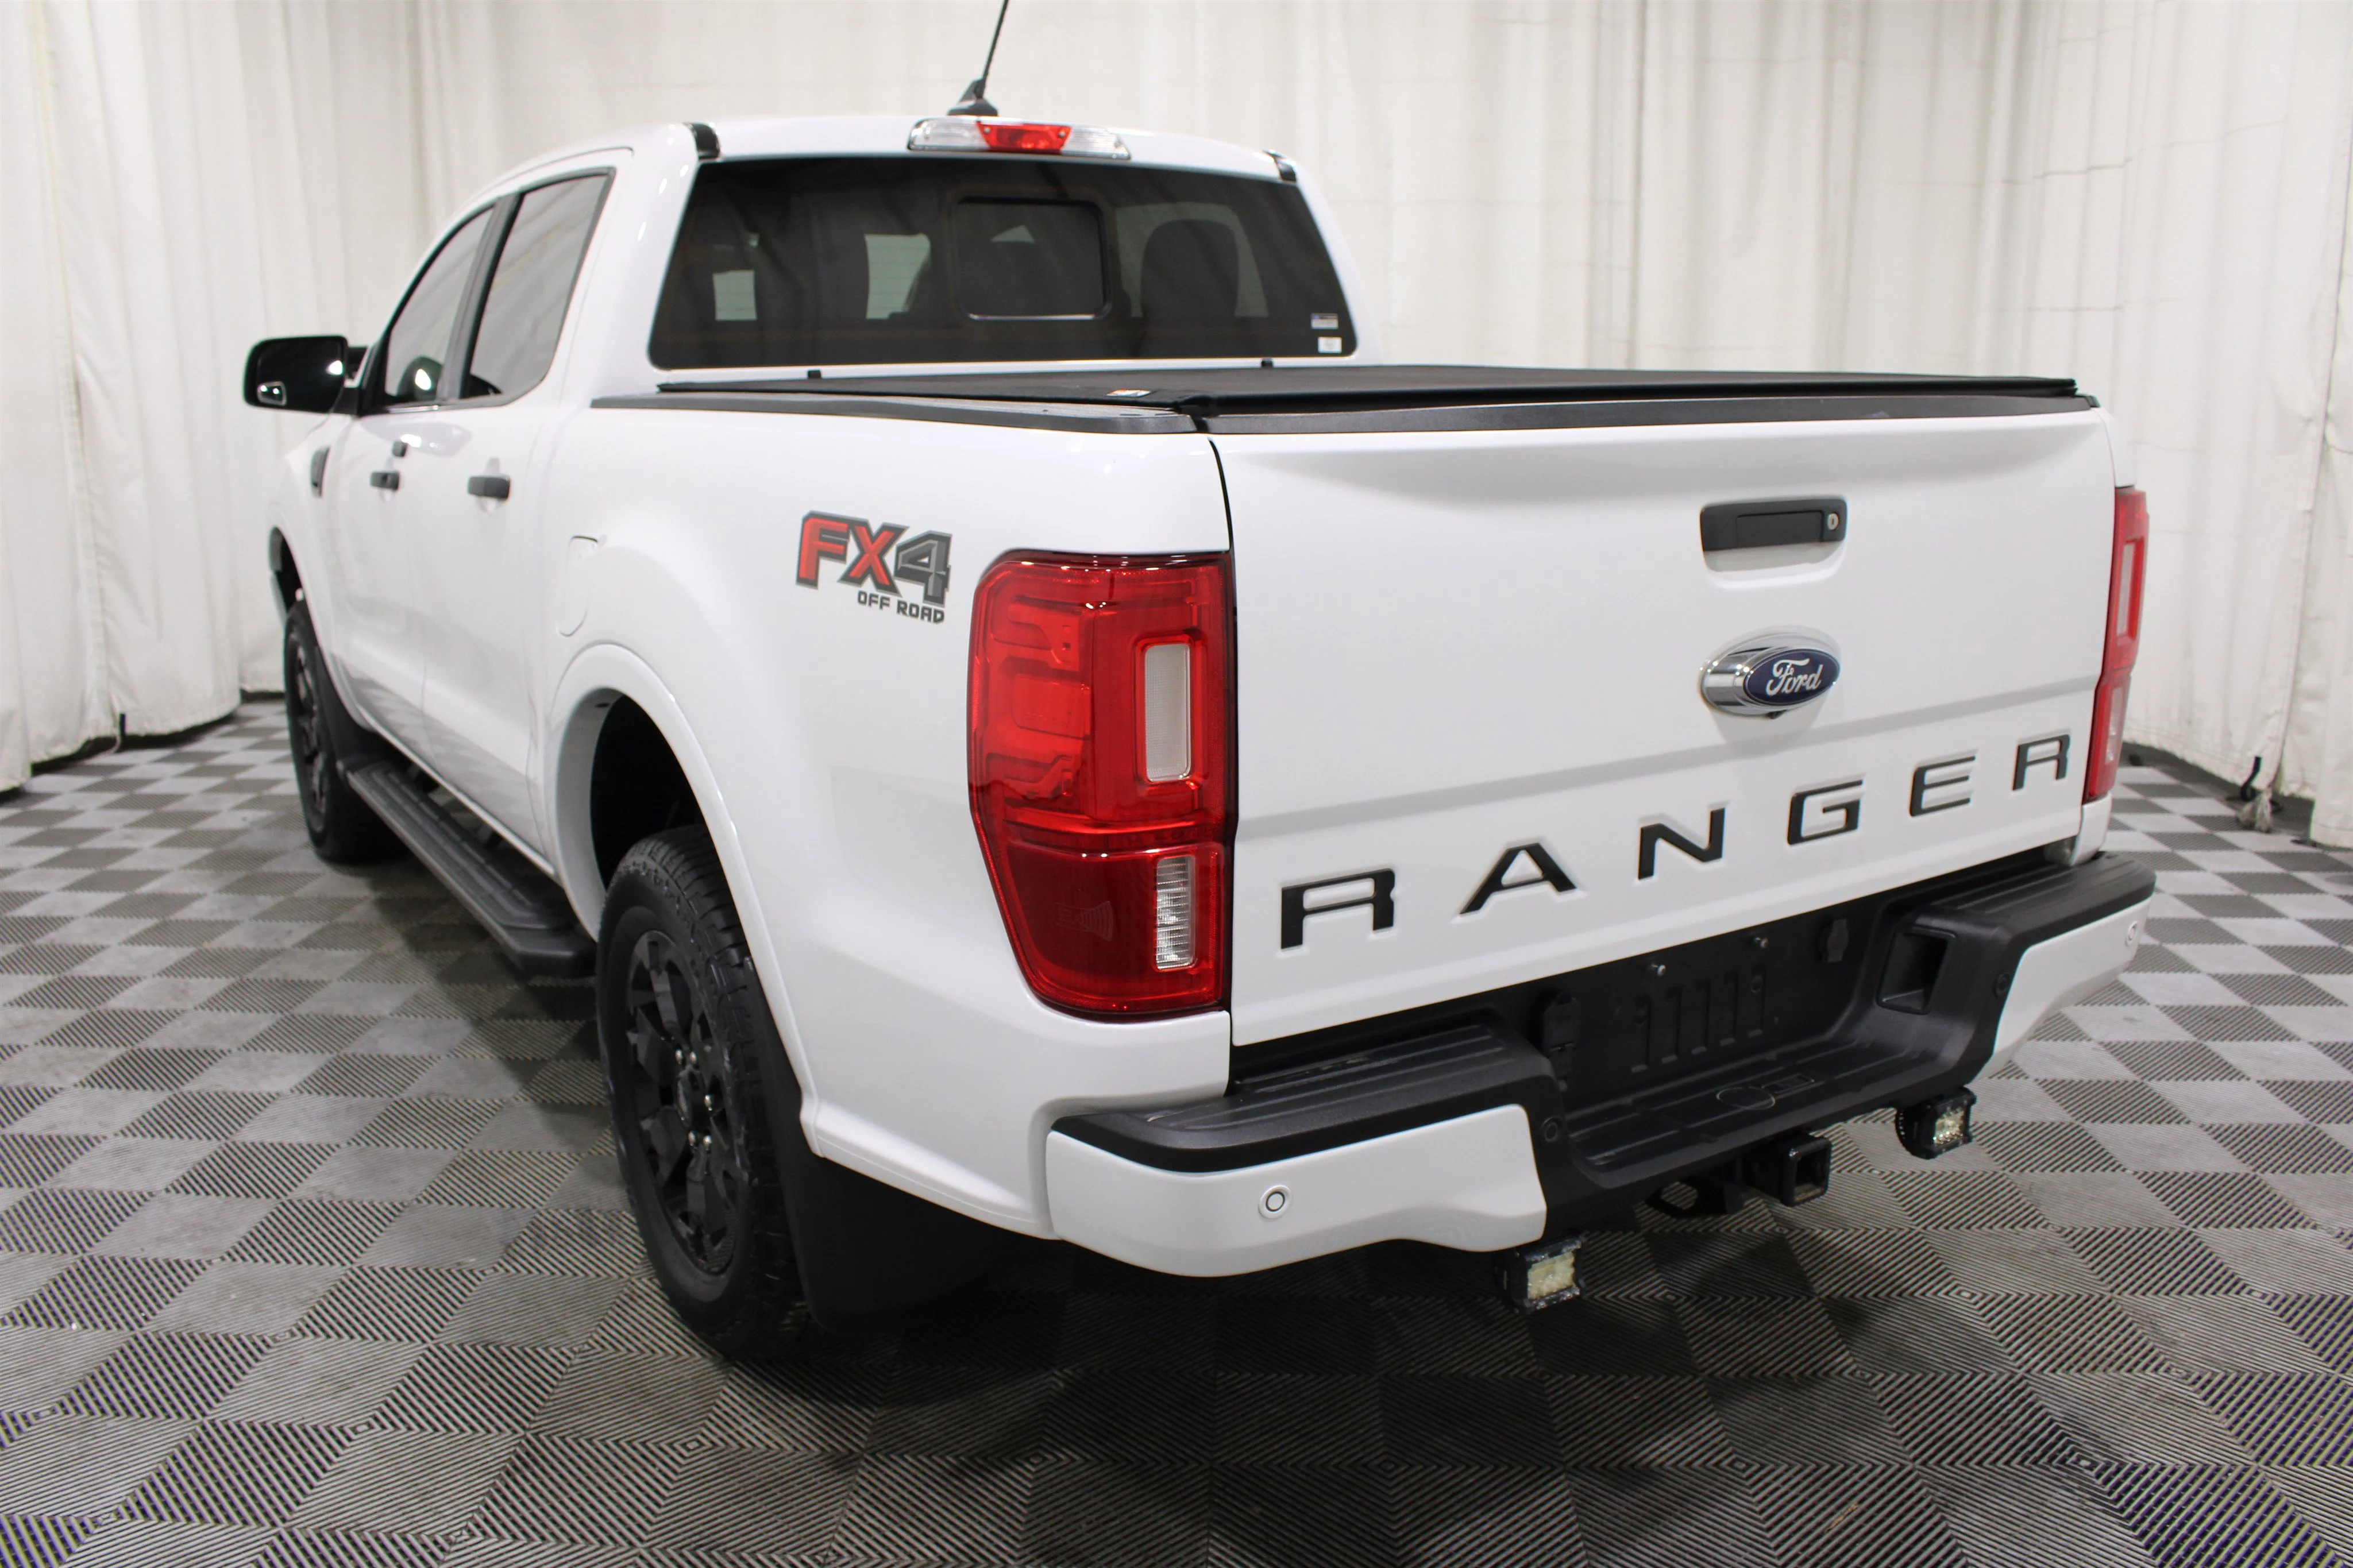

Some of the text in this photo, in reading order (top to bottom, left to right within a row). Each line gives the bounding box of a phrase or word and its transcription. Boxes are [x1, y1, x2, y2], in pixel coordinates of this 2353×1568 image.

[796, 510, 952, 607] FX4
[857, 590, 945, 624] OFF ROAD
[1766, 658, 1824, 697] Ford
[1281, 733, 2071, 950] RANGER
